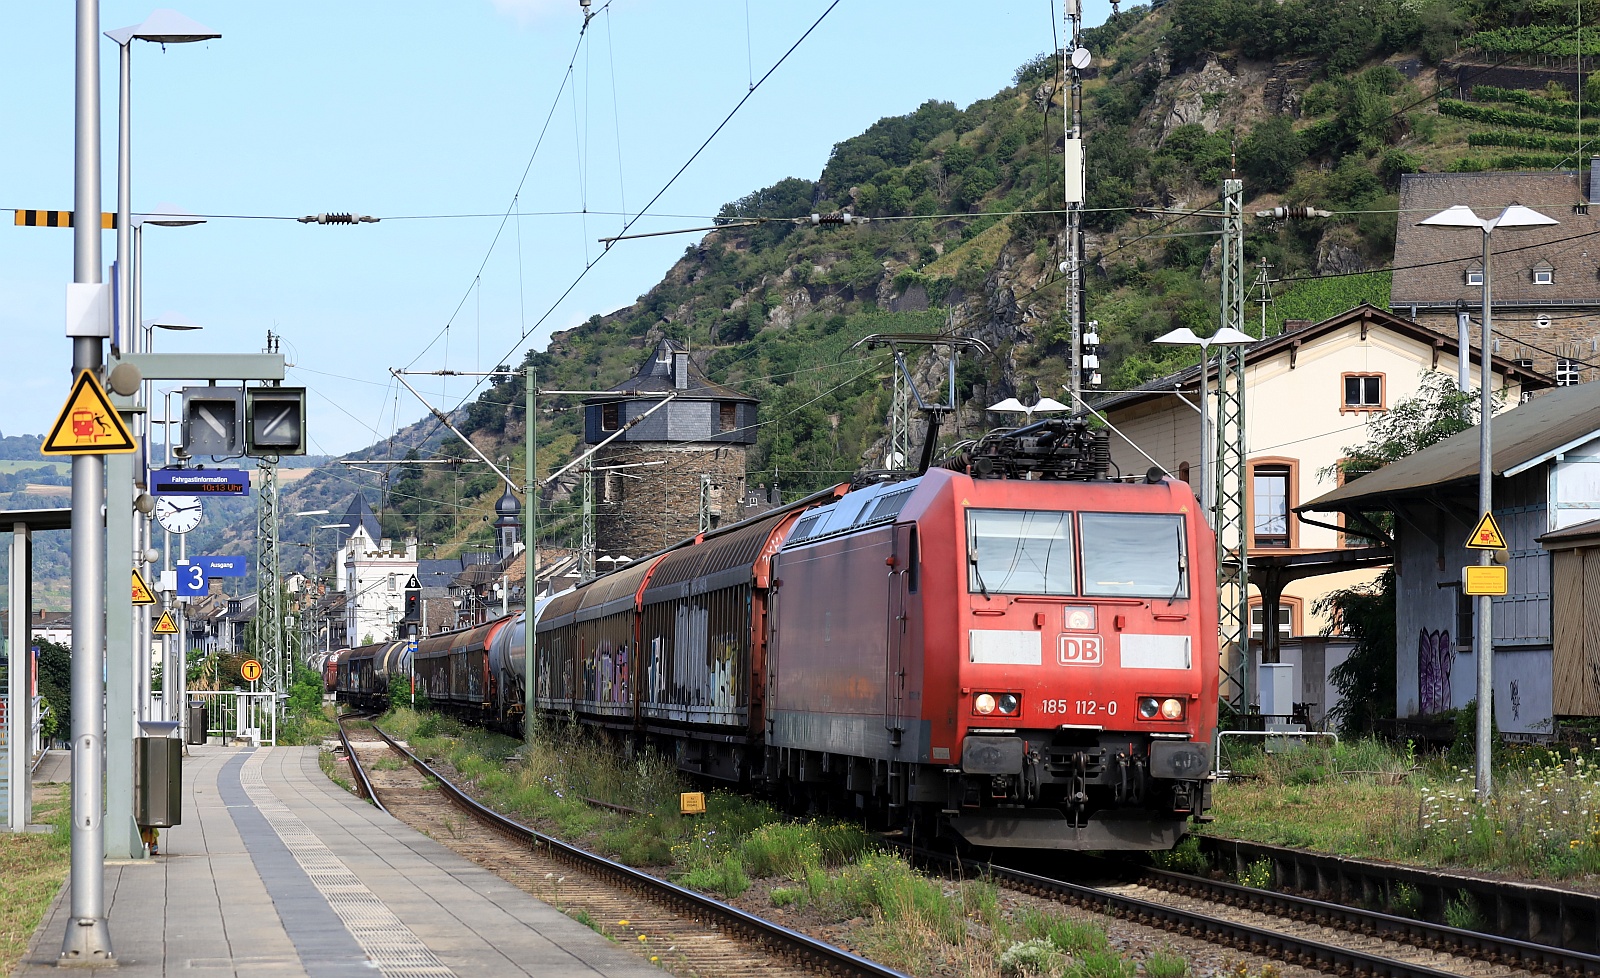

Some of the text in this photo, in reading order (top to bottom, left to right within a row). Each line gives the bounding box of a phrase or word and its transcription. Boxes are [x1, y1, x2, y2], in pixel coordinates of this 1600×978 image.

[171, 476, 228, 484] Fahrgastinformation
[201, 484, 243, 492] 10:13 Uhr
[187, 565, 204, 590] 3
[410, 577, 416, 588] 6
[1063, 639, 1098, 661] DB
[1042, 699, 1117, 716] 185 112-0
